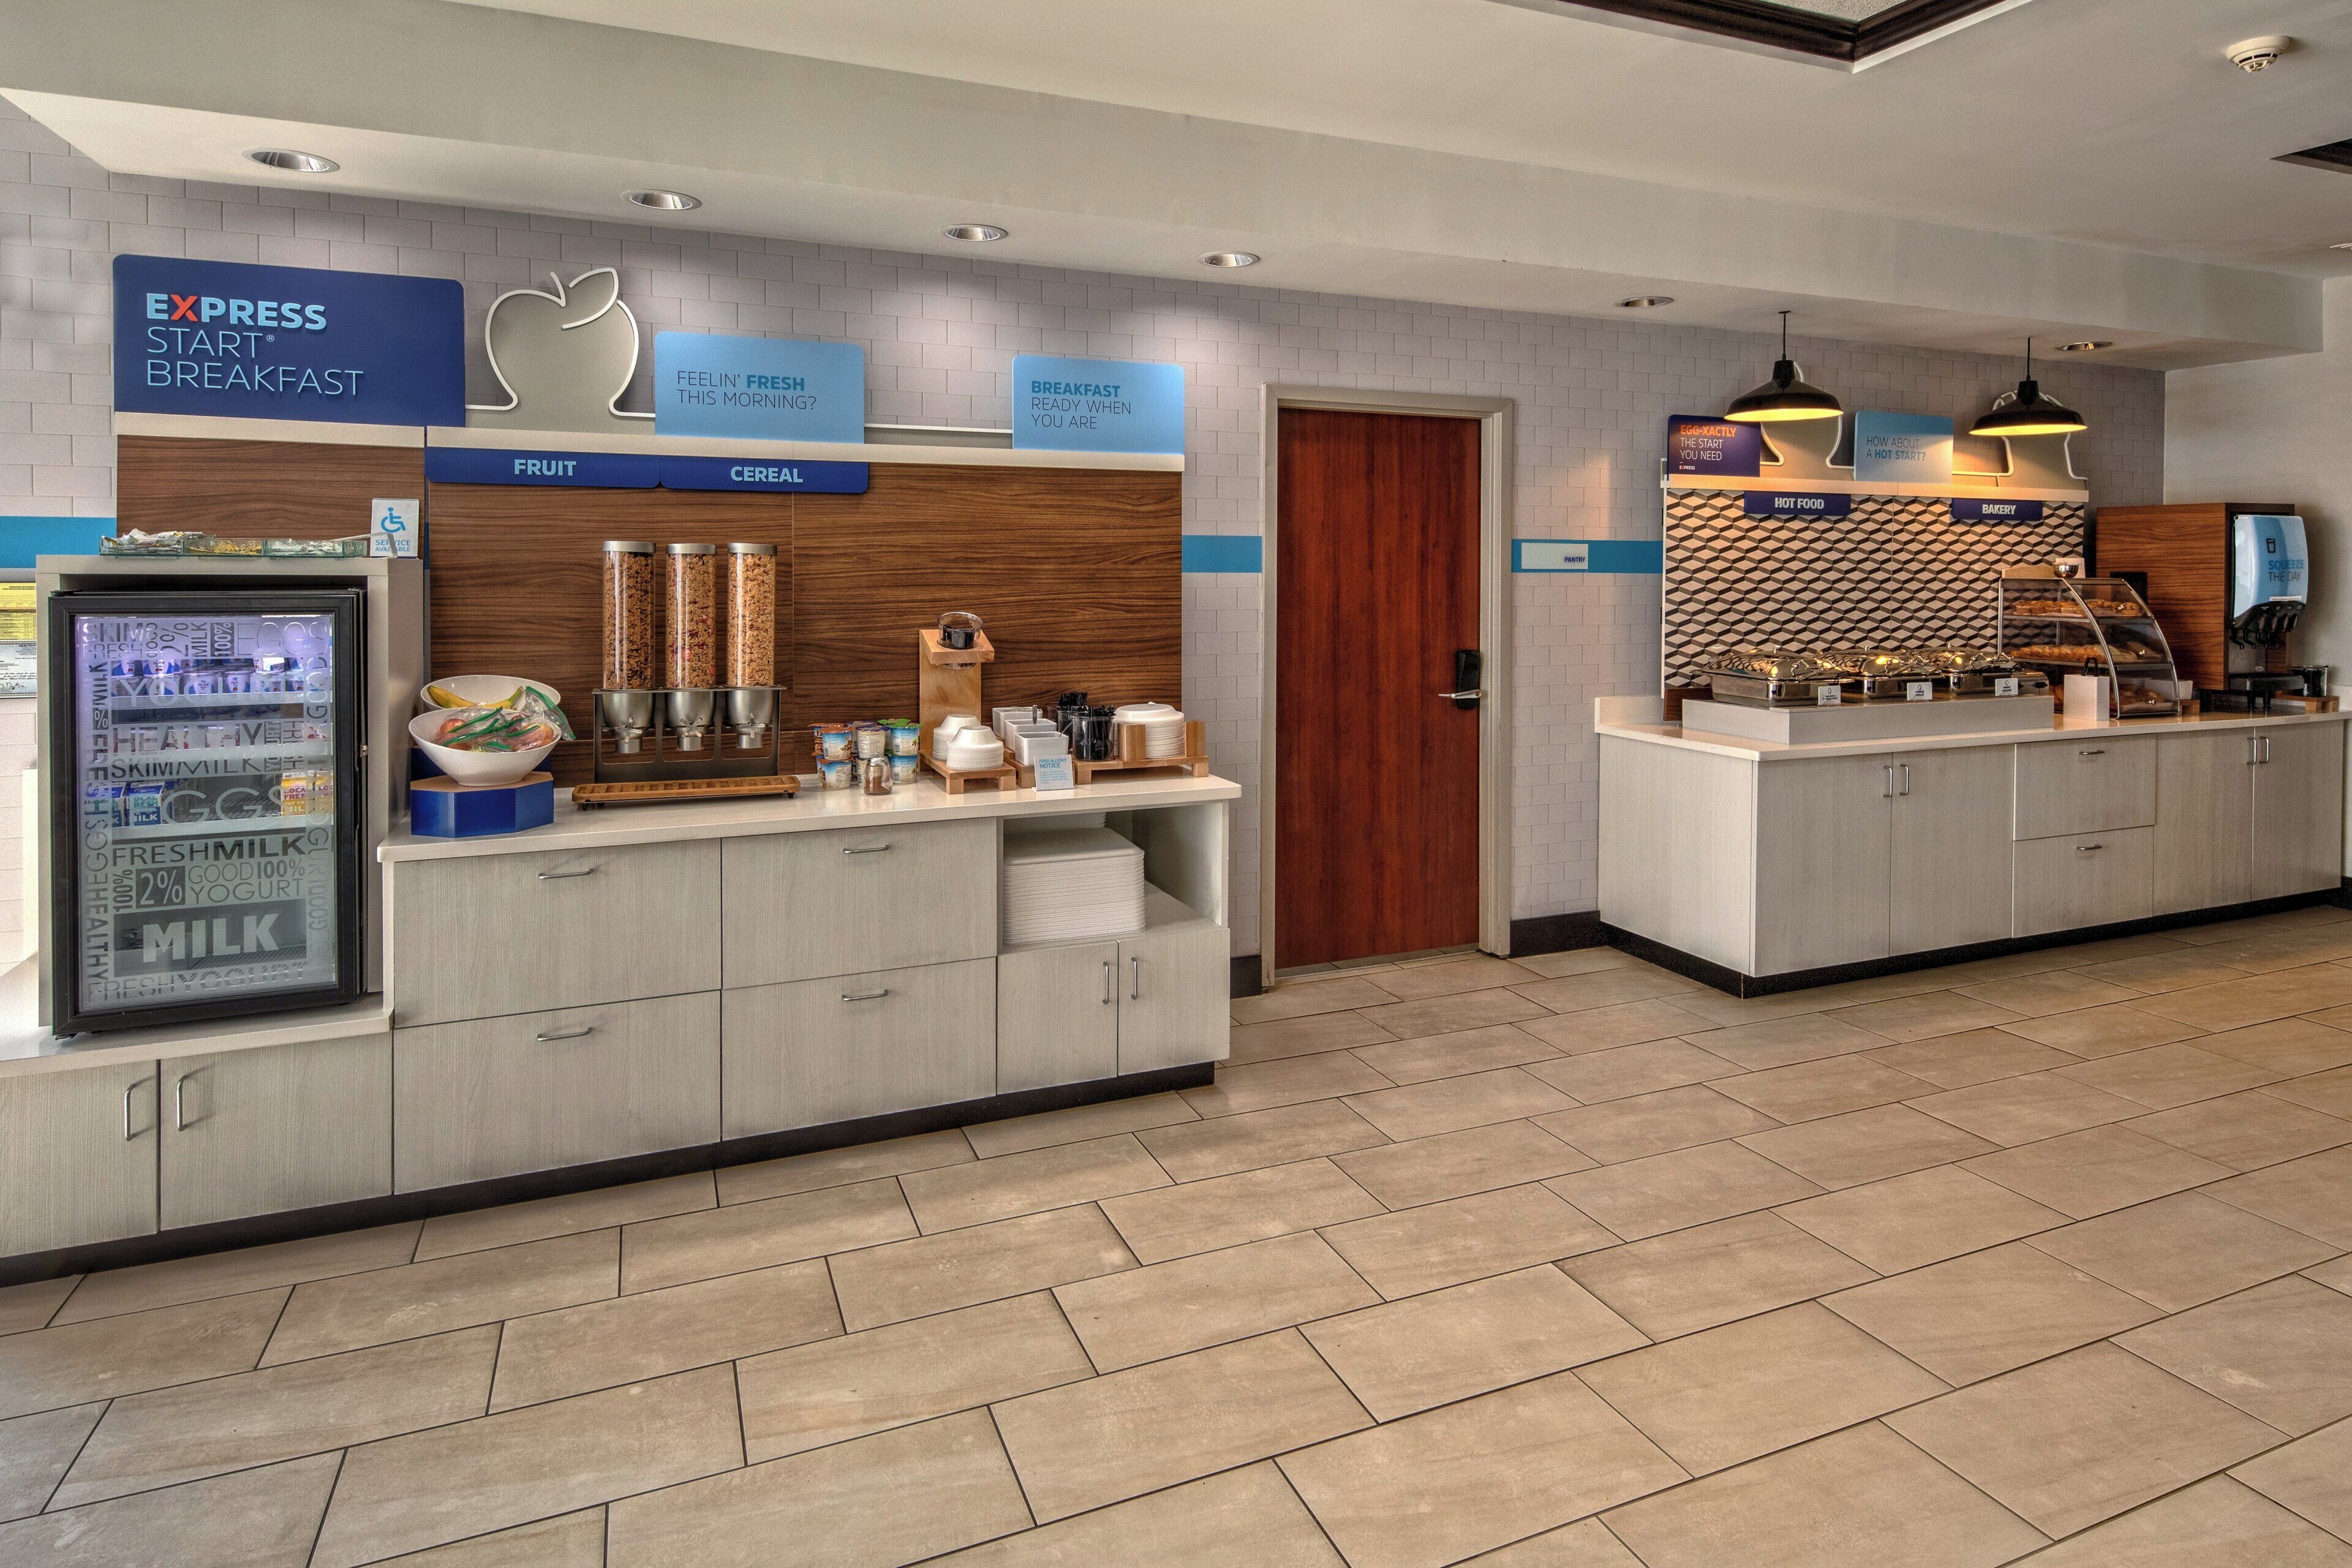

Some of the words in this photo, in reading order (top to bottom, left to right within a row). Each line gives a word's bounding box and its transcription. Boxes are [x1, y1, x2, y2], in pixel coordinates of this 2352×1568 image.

[147, 293, 326, 330] EXPRESS
[148, 360, 364, 396] BREAKFAST
[747, 374, 805, 391] FRESH
[1031, 381, 1121, 398] BREAKFAST
[677, 389, 717, 405] THIS
[723, 392, 817, 410] MORNING?
[1031, 398, 1081, 412] READY
[1086, 400, 1131, 415] WHEN
[1031, 413, 1063, 428] YOU
[1069, 416, 1098, 429] ARE
[1680, 425, 1737, 437] EGG-XACTLY
[1680, 438, 1696, 448] THE
[1698, 439, 1724, 449] START
[1867, 437, 1888, 447] HOW
[1891, 438, 1920, 449] ABOUT
[1680, 450, 1698, 460] YOU
[1700, 451, 1722, 461] NEED
[1866, 449, 1872, 458] A
[1875, 449, 1893, 459] HOT
[1895, 450, 1926, 461] START?
[514, 459, 577, 477] FRUIT
[730, 466, 803, 483] CEREAL
[1774, 497, 1795, 508] HOT
[1798, 499, 1825, 510] FOOD
[1982, 504, 2016, 515] BAKERY
[2268, 560, 2304, 570] SQUEEZE
[2268, 571, 2285, 582] THE
[2288, 571, 2301, 582] DAY
[83, 622, 144, 643] SKIM
[190, 622, 208, 658] MILK
[214, 622, 232, 657] 100%
[265, 722, 281, 772] YOURT
[112, 869, 134, 913] 100%
[140, 870, 183, 905] 2%
[190, 878, 304, 904] YOGURT
[86, 888, 109, 982] HEALTHY
[143, 913, 279, 963] MILK
